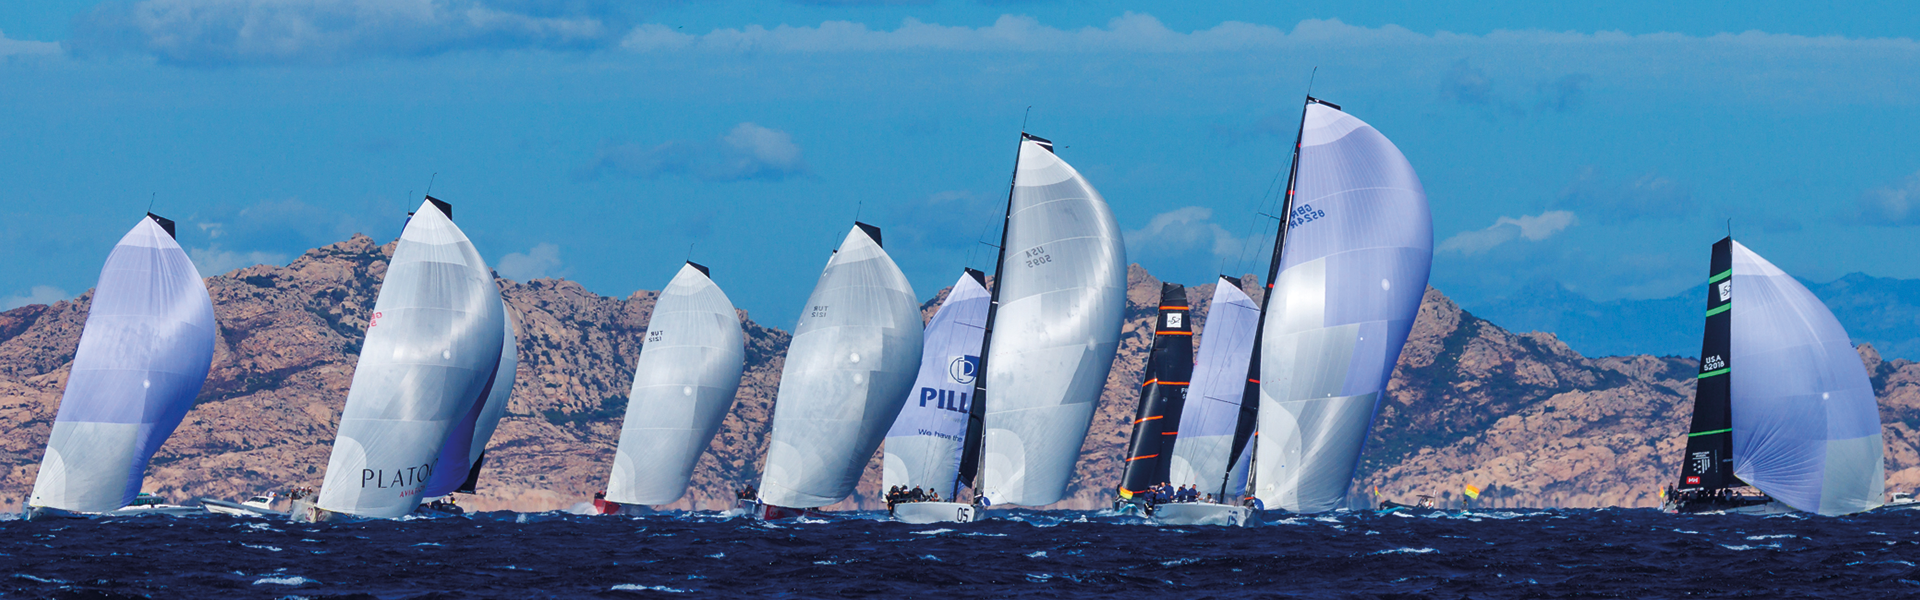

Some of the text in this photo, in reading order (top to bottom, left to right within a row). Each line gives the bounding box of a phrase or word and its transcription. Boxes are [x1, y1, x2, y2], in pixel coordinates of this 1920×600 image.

[1706, 355, 1721, 364] USA
[918, 429, 963, 443] We have the
[957, 507, 969, 523] 05
